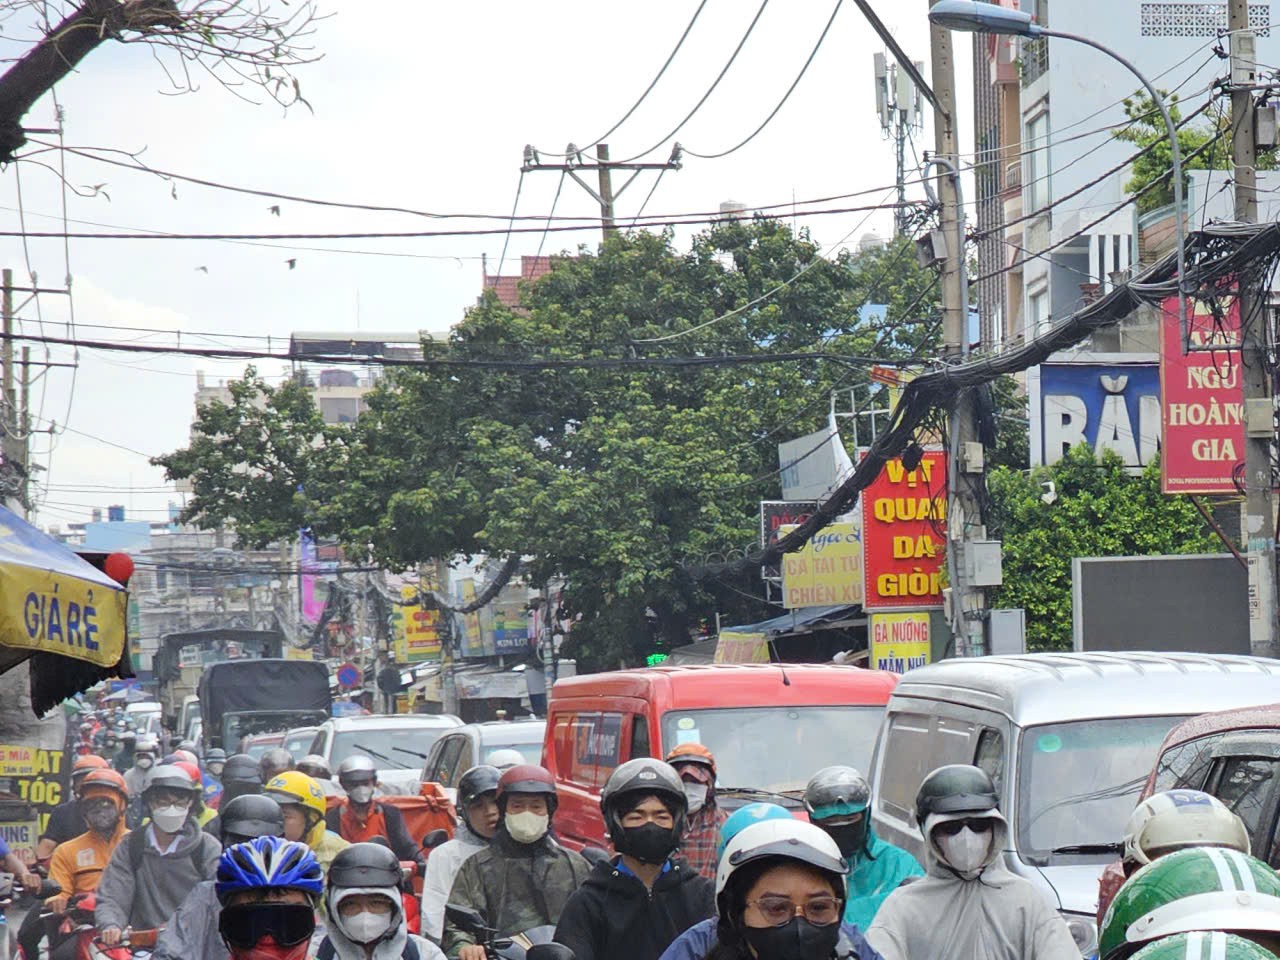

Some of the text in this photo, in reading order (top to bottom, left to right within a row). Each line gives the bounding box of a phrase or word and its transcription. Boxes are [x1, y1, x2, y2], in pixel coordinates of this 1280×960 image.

[1187, 360, 1240, 389] NGỮ
[1191, 438, 1238, 461] GIA
[885, 458, 936, 488] VỊT
[893, 535, 937, 560] DA
[23, 582, 100, 651] GIÁ RẺ
[874, 616, 929, 643] GÀ NƯỚNG
[18, 776, 62, 806] TÓC
